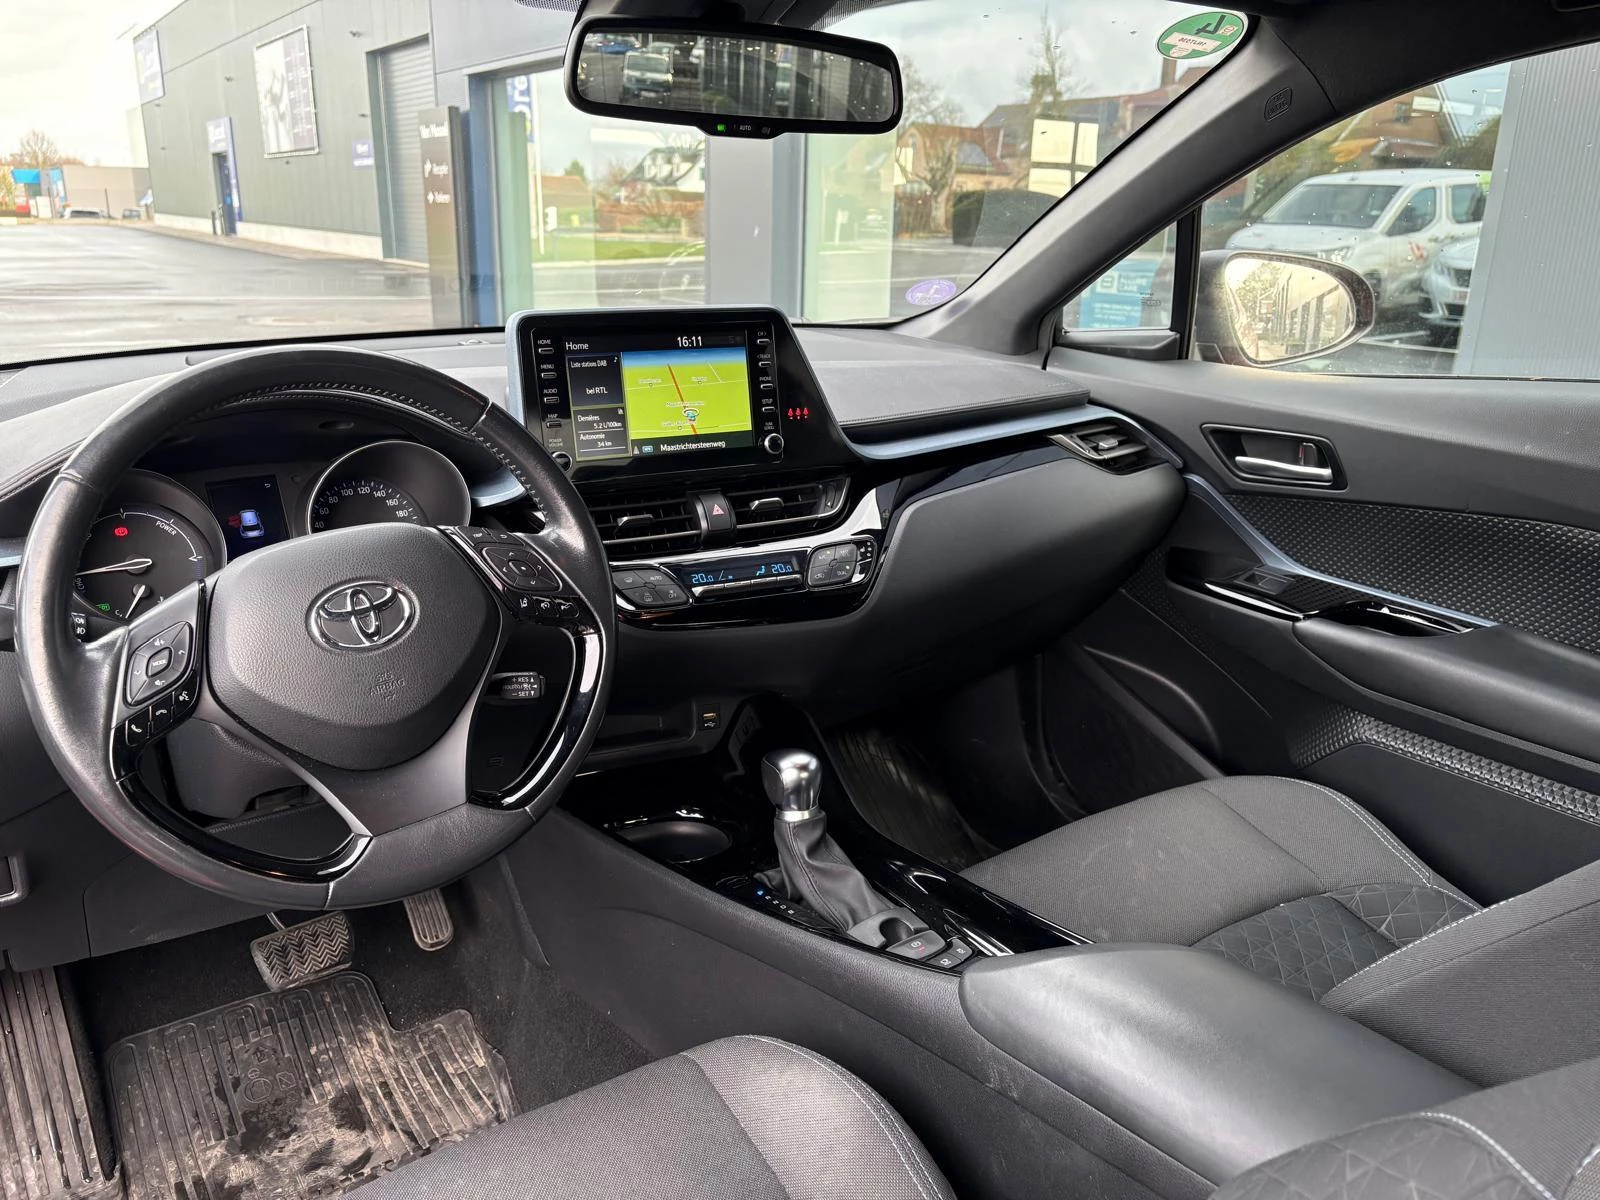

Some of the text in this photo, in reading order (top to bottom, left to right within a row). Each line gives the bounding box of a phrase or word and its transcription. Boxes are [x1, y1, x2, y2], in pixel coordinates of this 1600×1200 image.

[565, 341, 589, 350] Home
[677, 335, 702, 347] 16:11
[585, 386, 608, 395] bel RTL
[660, 440, 726, 452] Maastrichtersteenweg
[340, 488, 354, 497] 100
[357, 486, 371, 495] 120
[373, 489, 386, 498] 140
[328, 495, 339, 504] 80
[386, 498, 399, 507] 160
[320, 507, 329, 515] 60
[396, 509, 408, 518] 180
[155, 520, 177, 536] POWER
[314, 521, 324, 529] 40
[771, 563, 793, 574] 20.0
